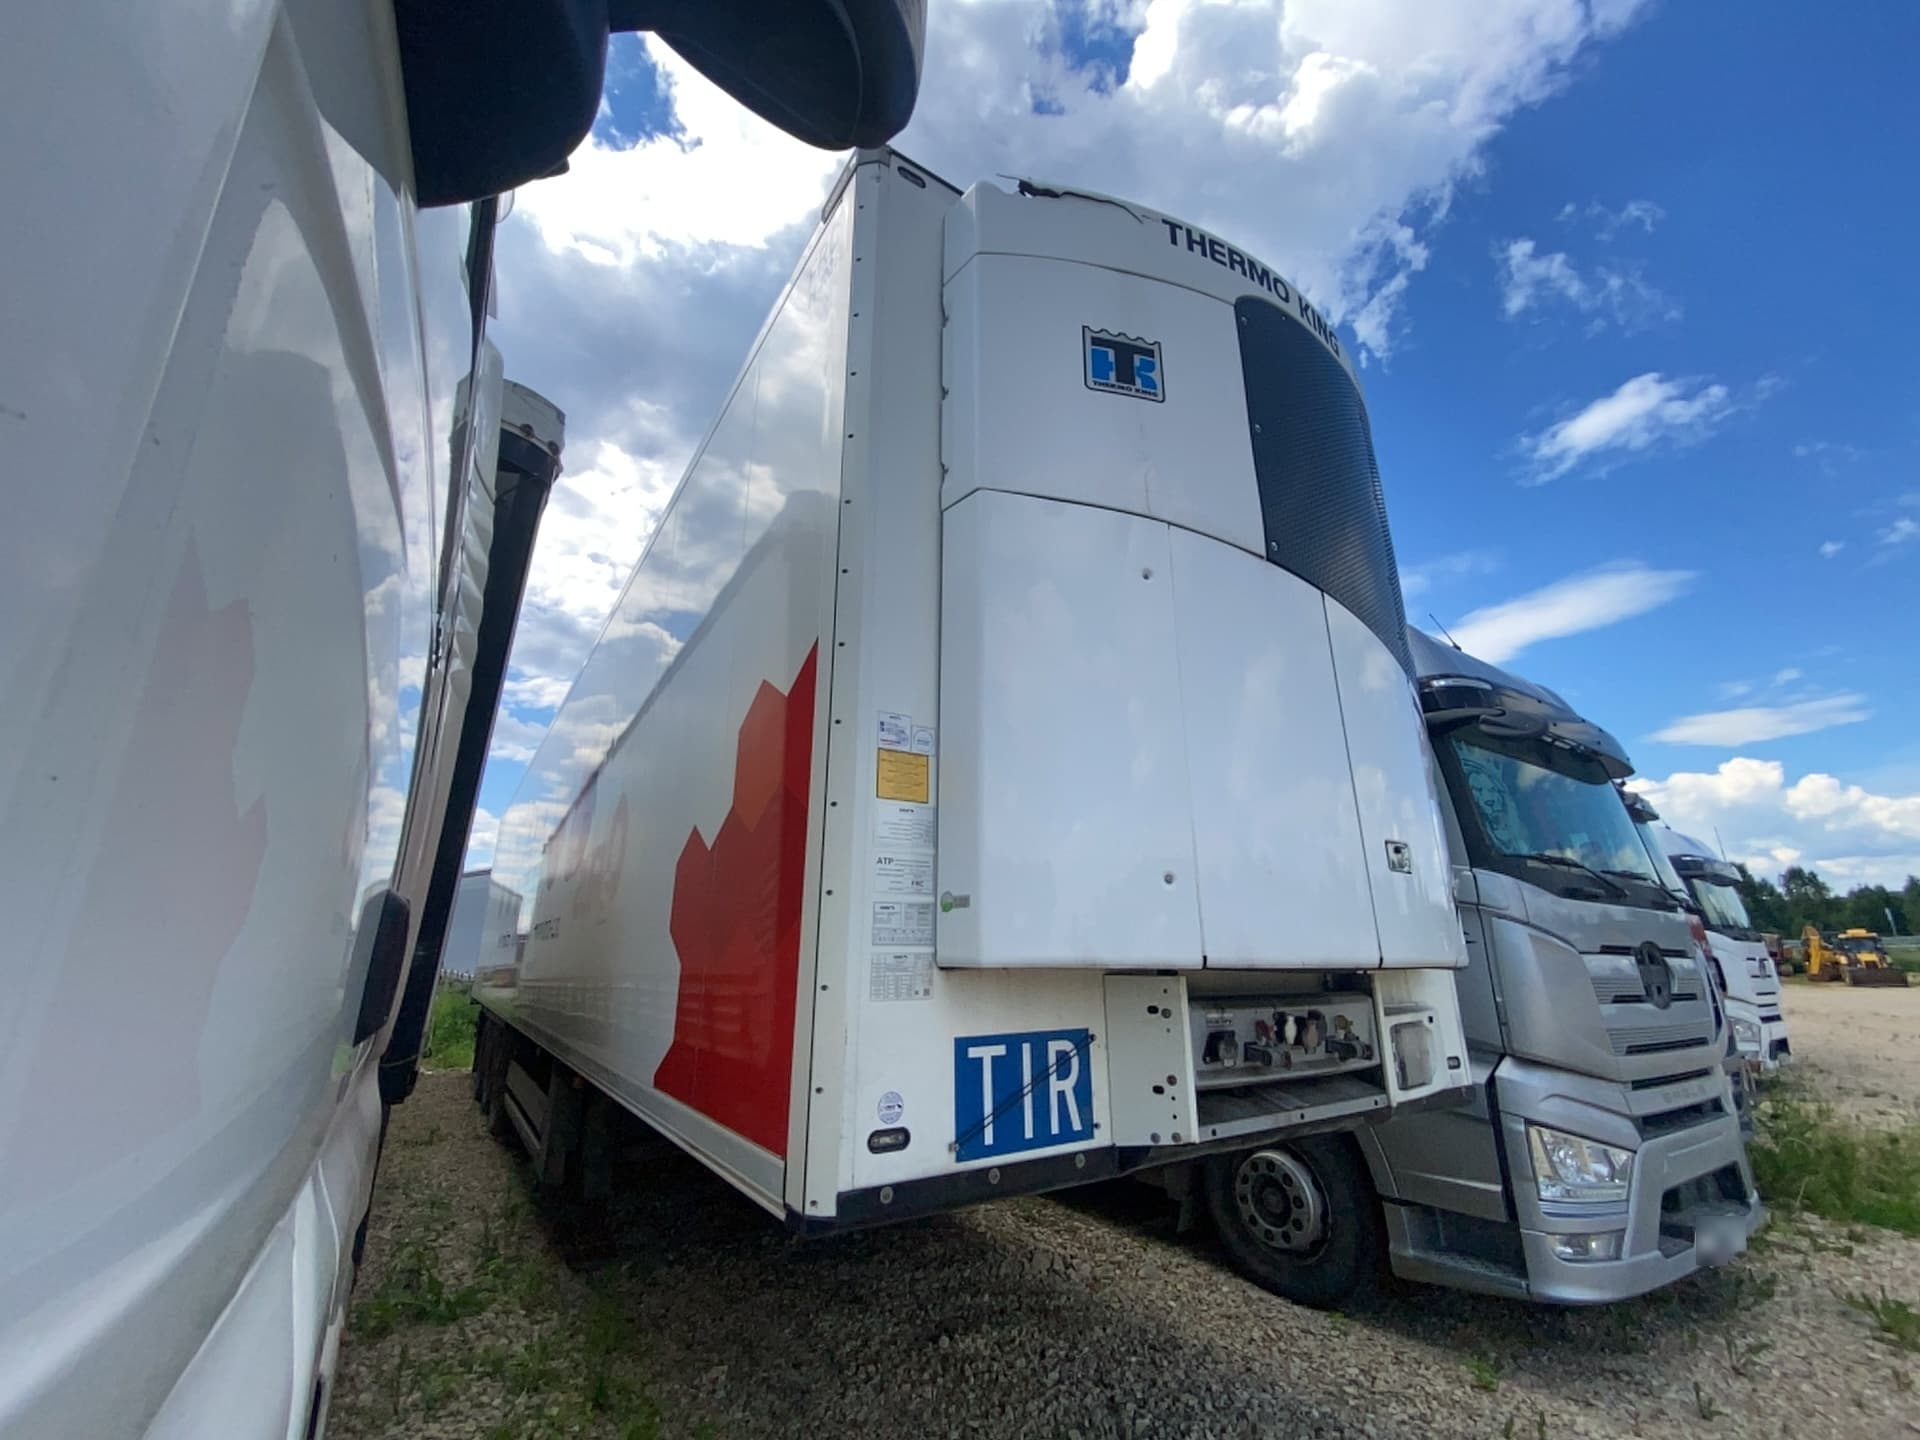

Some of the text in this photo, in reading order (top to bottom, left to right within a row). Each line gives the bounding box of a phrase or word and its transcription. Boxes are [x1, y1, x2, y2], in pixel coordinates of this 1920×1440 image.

[1161, 218, 1339, 357] THERMO KING
[876, 856, 894, 865] ATP
[968, 1039, 1082, 1146] TIR
